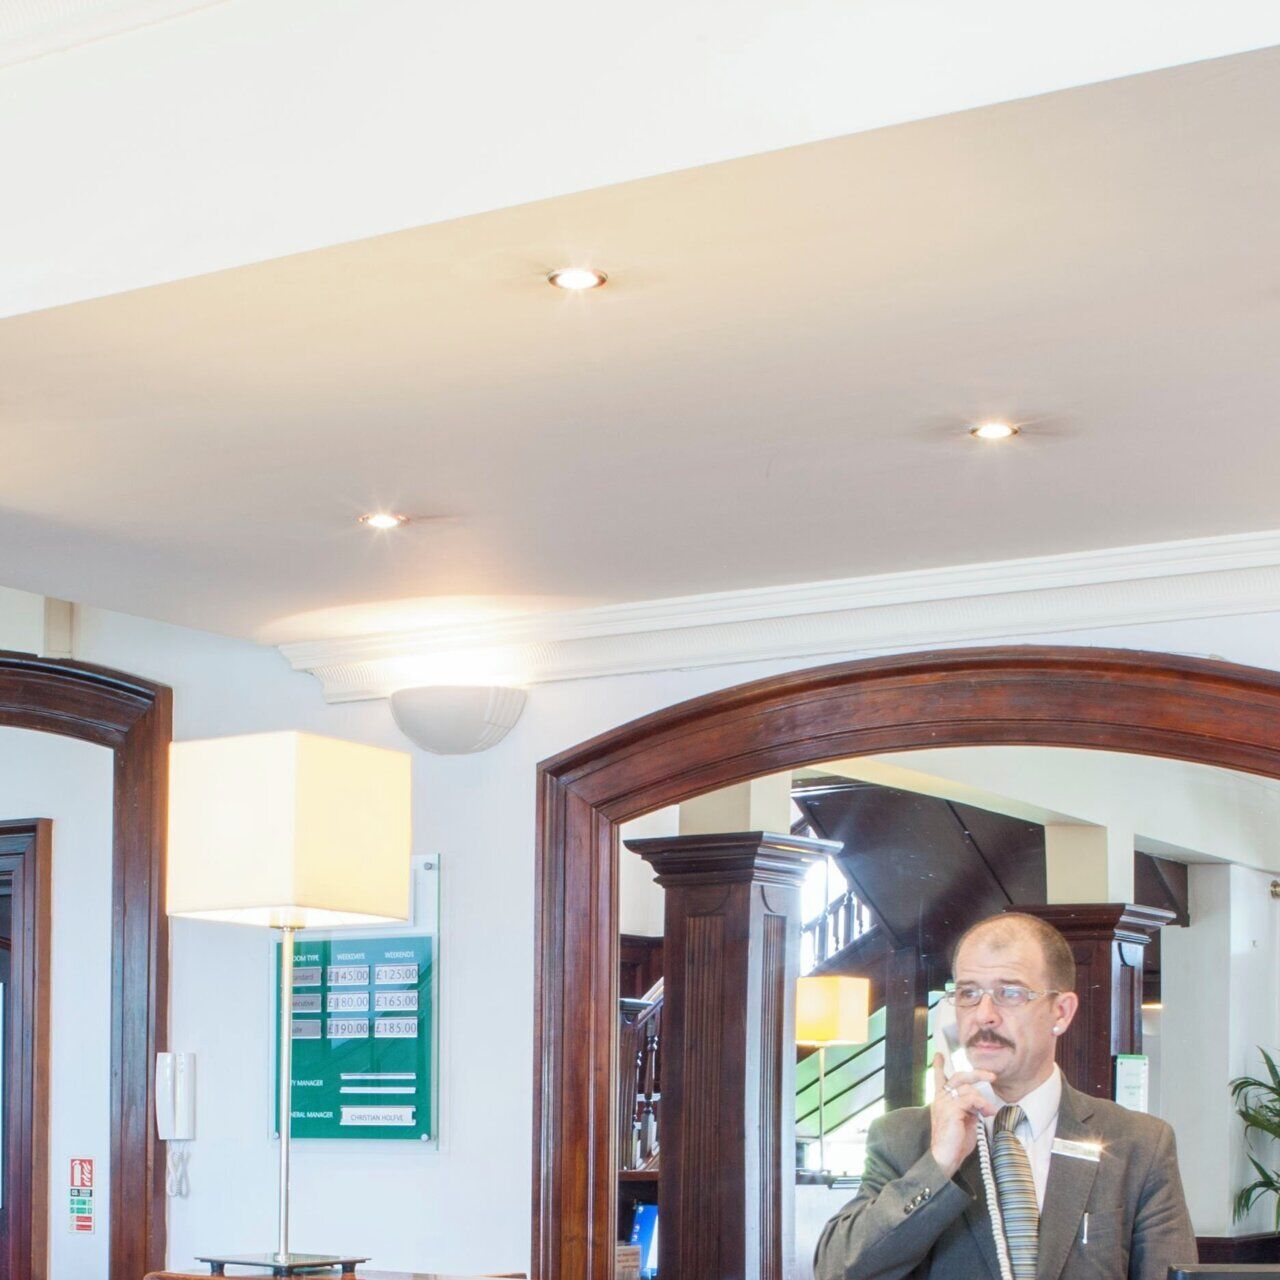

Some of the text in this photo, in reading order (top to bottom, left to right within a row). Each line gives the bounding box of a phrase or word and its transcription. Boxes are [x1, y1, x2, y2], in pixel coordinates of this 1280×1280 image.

[384, 951, 414, 959] WEEKENDS
[328, 970, 369, 982] £145.00
[376, 968, 417, 980] £125.00
[328, 997, 369, 1008] £180.00
[376, 995, 417, 1006] £165.00
[328, 1023, 369, 1034] £190.00
[376, 1022, 417, 1033] £185.00
[297, 1079, 324, 1087] MANAGER
[306, 1110, 333, 1119] MANAGER
